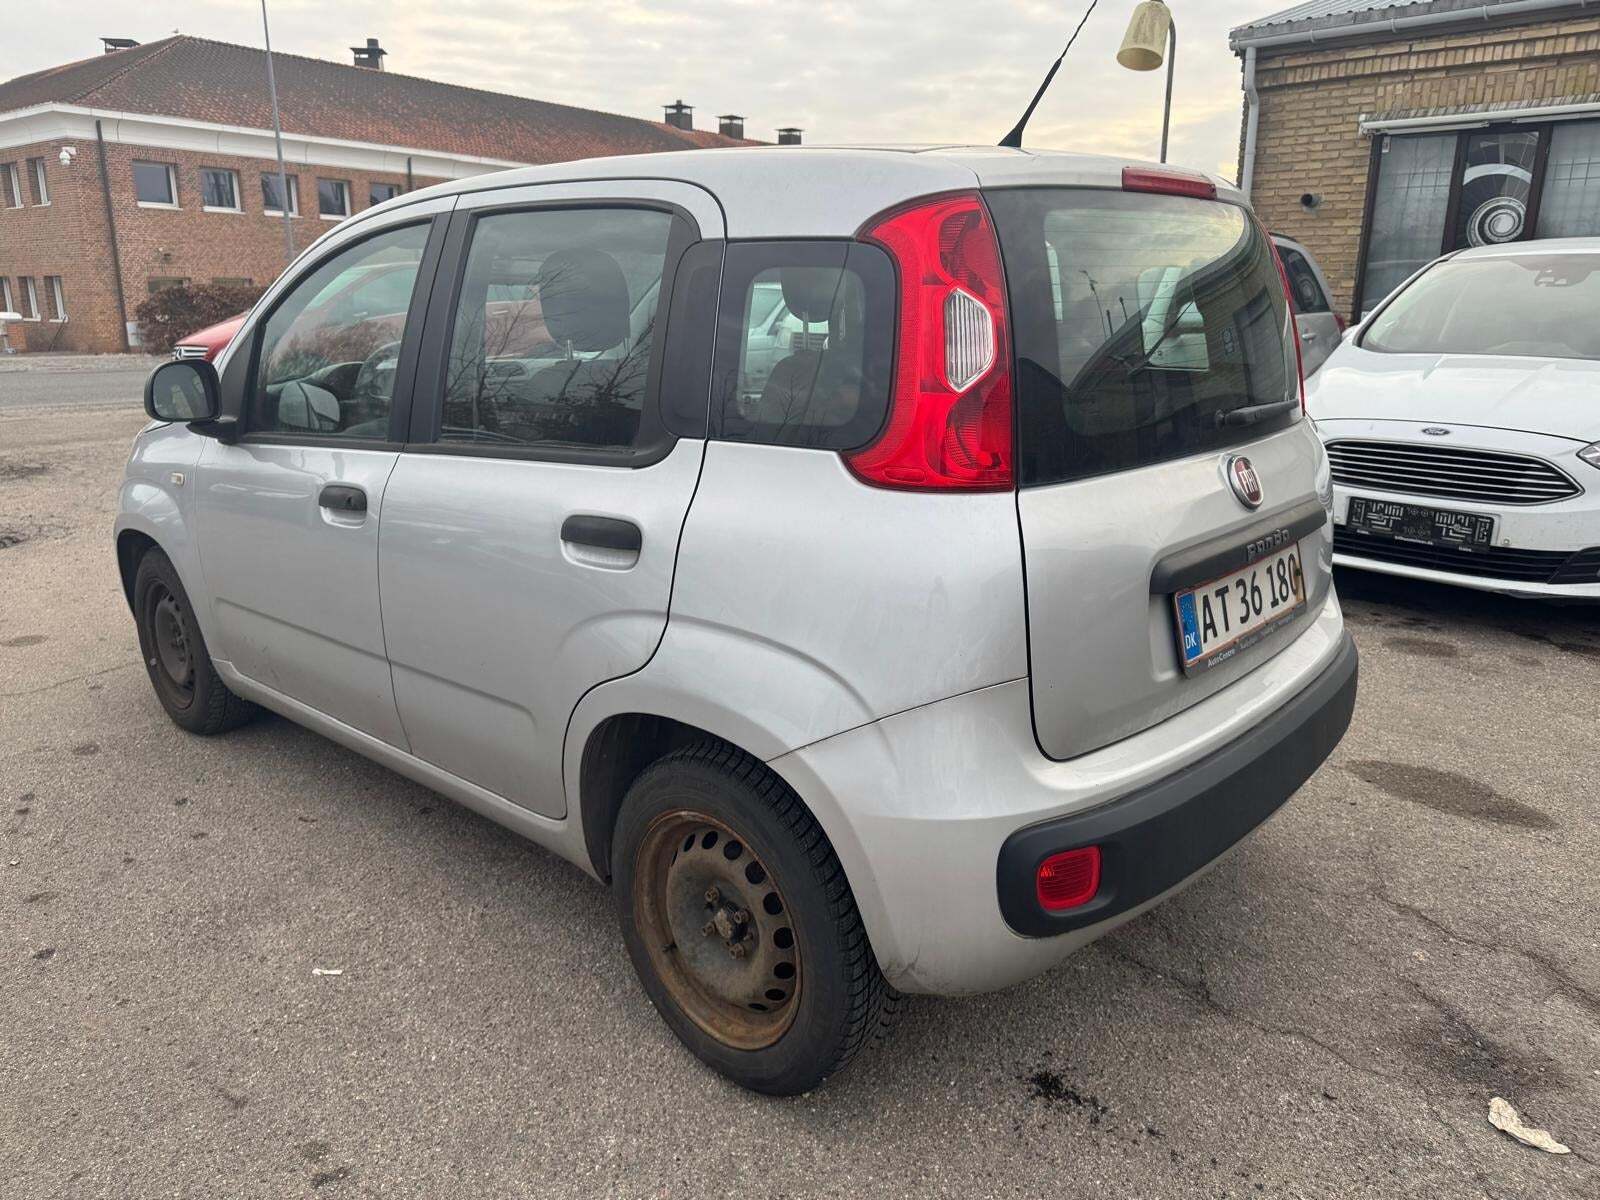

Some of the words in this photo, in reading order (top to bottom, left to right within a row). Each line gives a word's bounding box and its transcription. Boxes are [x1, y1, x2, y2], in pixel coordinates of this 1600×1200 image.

[1203, 585, 1230, 643] AT
[1235, 570, 1263, 624] 36
[1266, 553, 1298, 608] 180
[1185, 632, 1197, 649] DK
